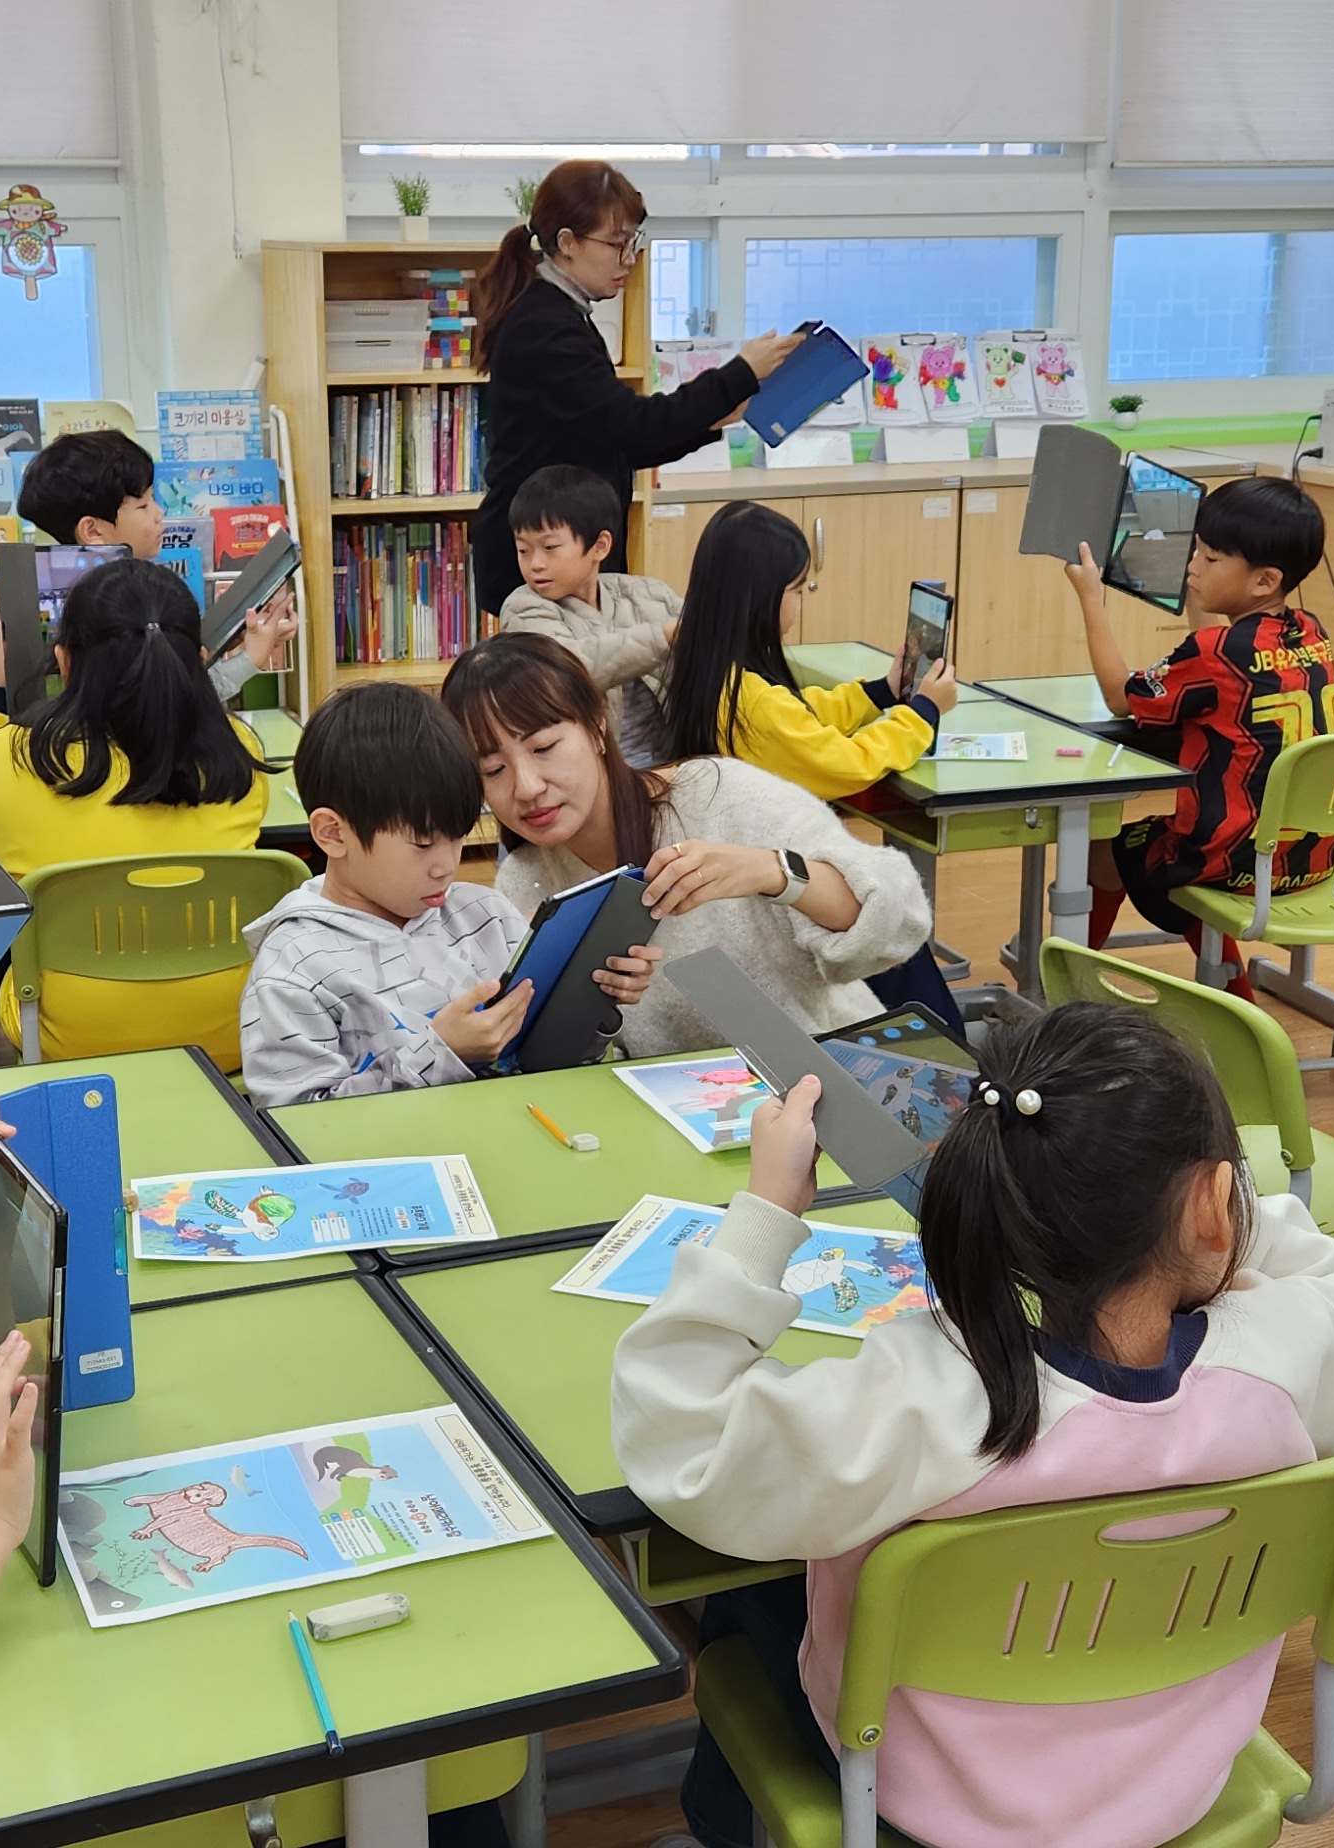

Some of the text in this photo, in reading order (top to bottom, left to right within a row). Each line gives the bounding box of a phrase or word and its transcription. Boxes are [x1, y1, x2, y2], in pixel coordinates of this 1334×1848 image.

[173, 410, 246, 427] 코끼리 미용실
[209, 482, 265, 496] 나의 바다
